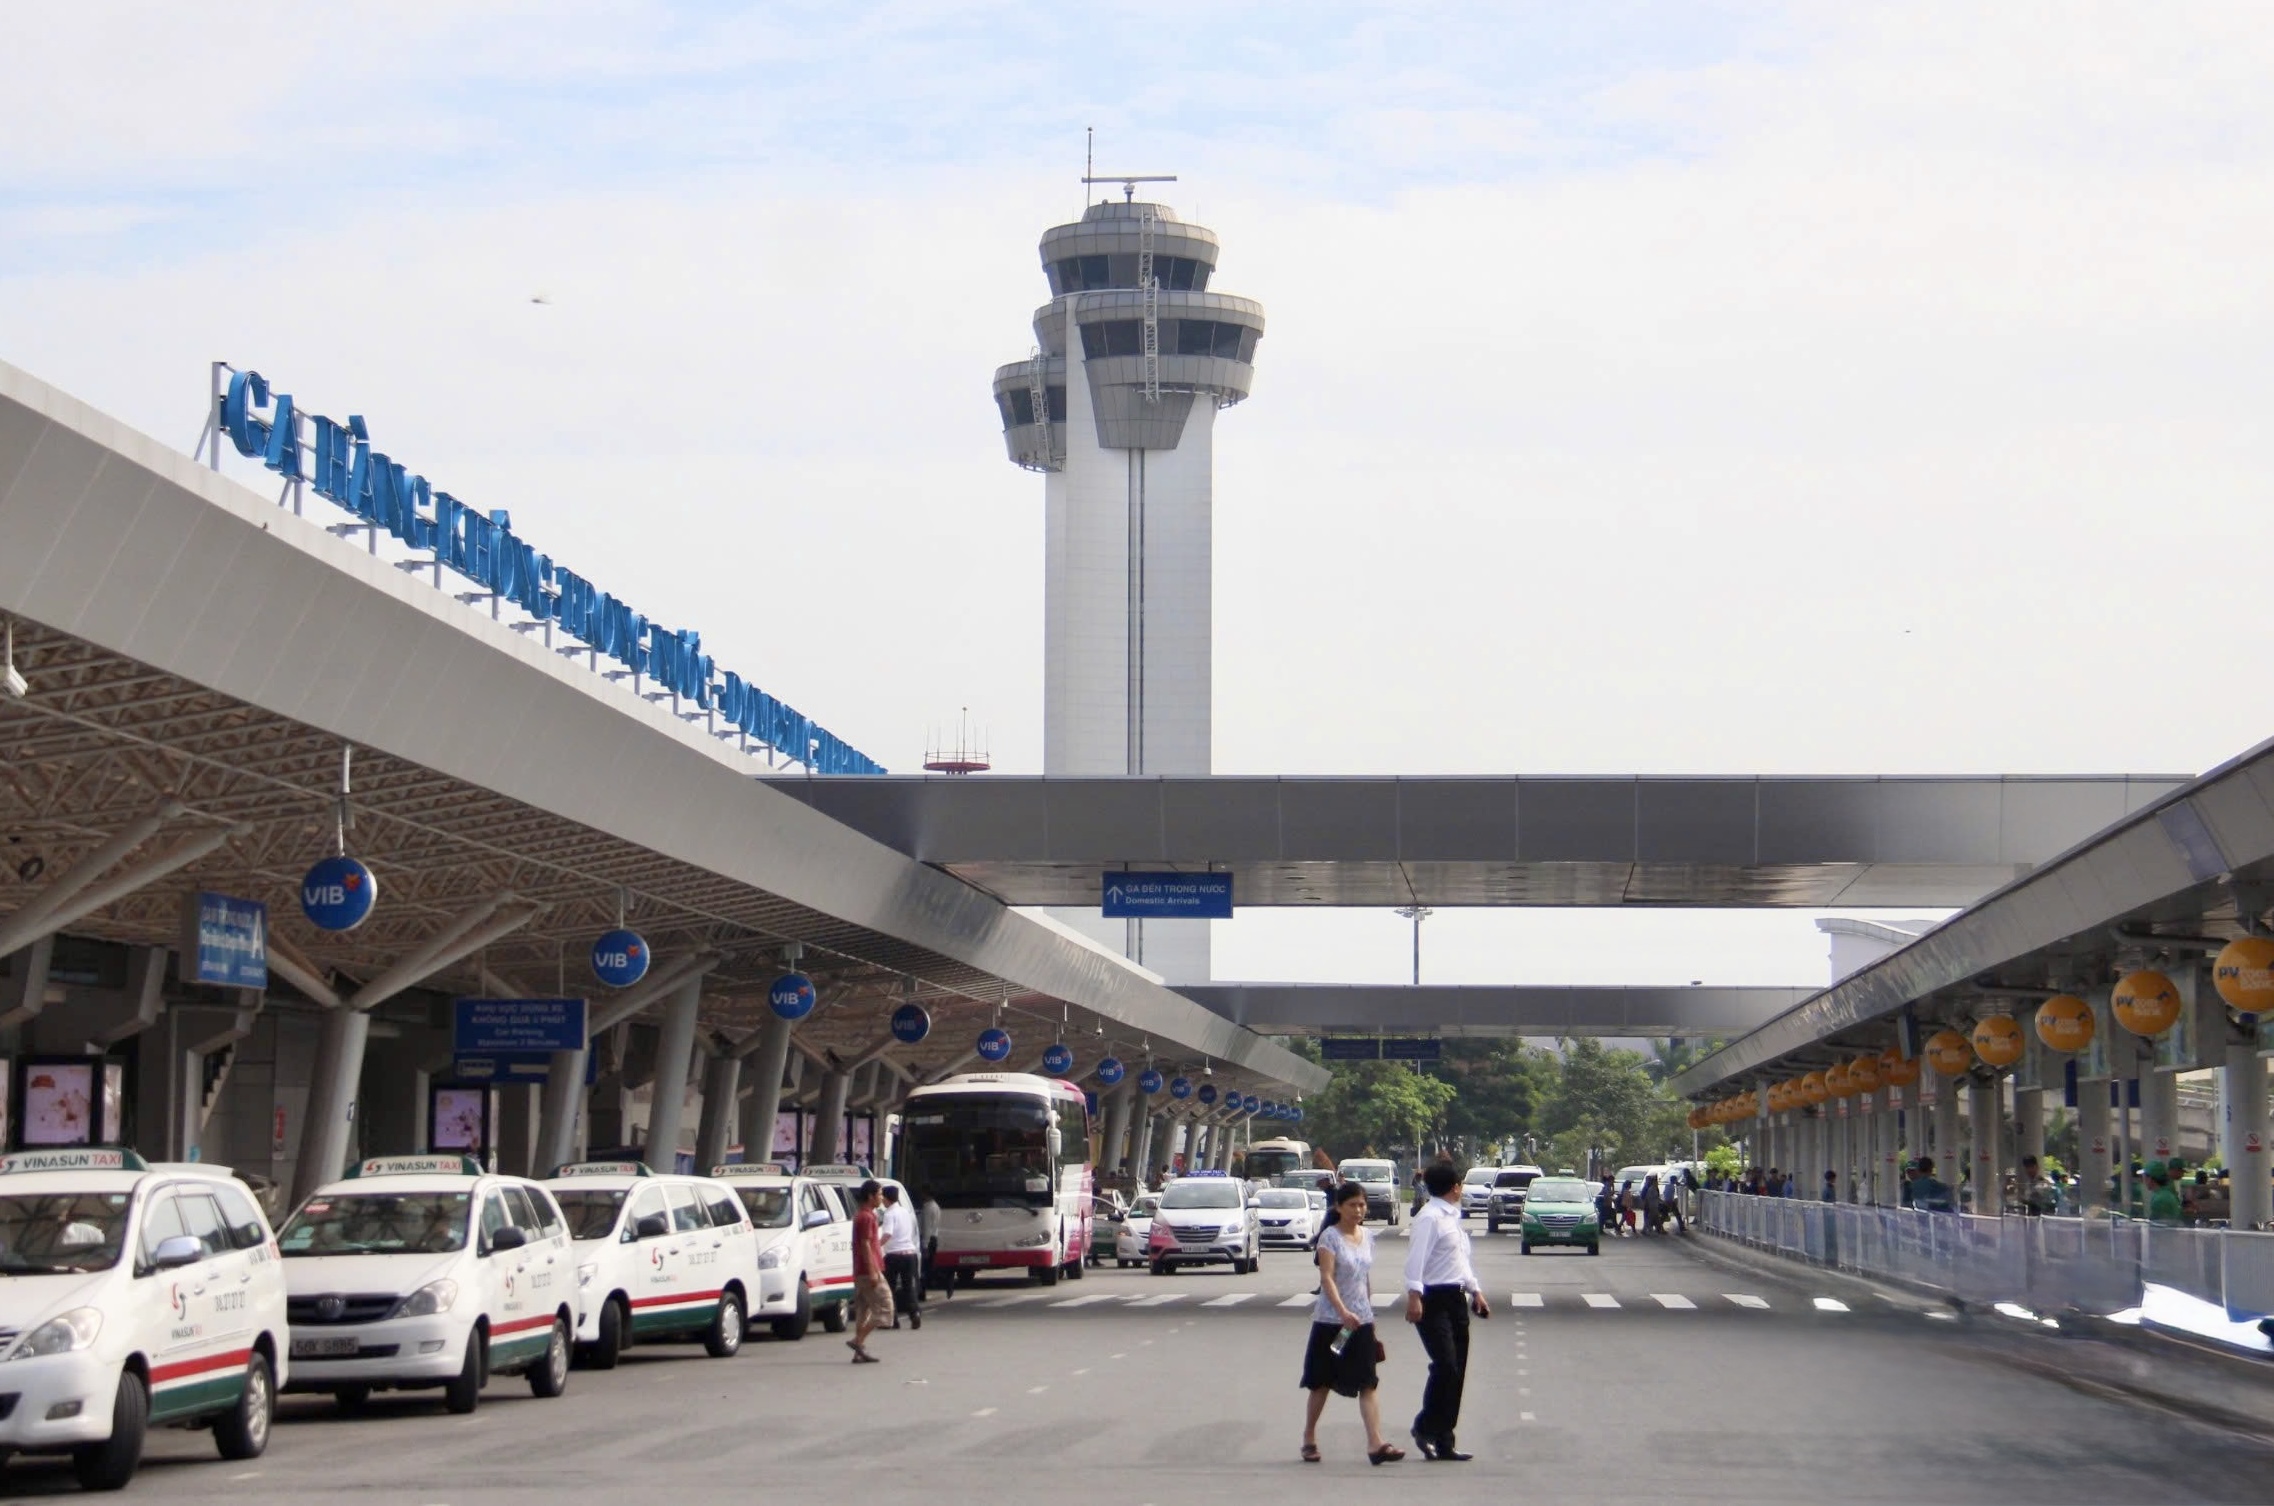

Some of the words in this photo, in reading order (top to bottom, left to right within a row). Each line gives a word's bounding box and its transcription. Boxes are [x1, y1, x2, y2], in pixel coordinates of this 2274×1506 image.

[1164, 885, 1196, 893] TRONG
[304, 885, 346, 906] VIB
[1125, 896, 1165, 905] Domestic
[1167, 896, 1200, 905] Arrivals
[594, 951, 629, 969] VIB
[771, 991, 800, 1006] VIB
[893, 1019, 917, 1032] VIB
[979, 1041, 999, 1052] VIB
[1043, 1055, 1062, 1066] VIB
[1098, 1067, 1115, 1077] VIB
[1139, 1078, 1154, 1088] VIB
[23, 1154, 90, 1168] VINASUN
[92, 1153, 122, 1165] TAXI
[387, 1161, 437, 1171] VINASUN
[439, 1161, 461, 1170] TAXI
[578, 1166, 618, 1174] VINASUN
[729, 1166, 764, 1174] VINASUN
[814, 1168, 844, 1176] VINASUN
